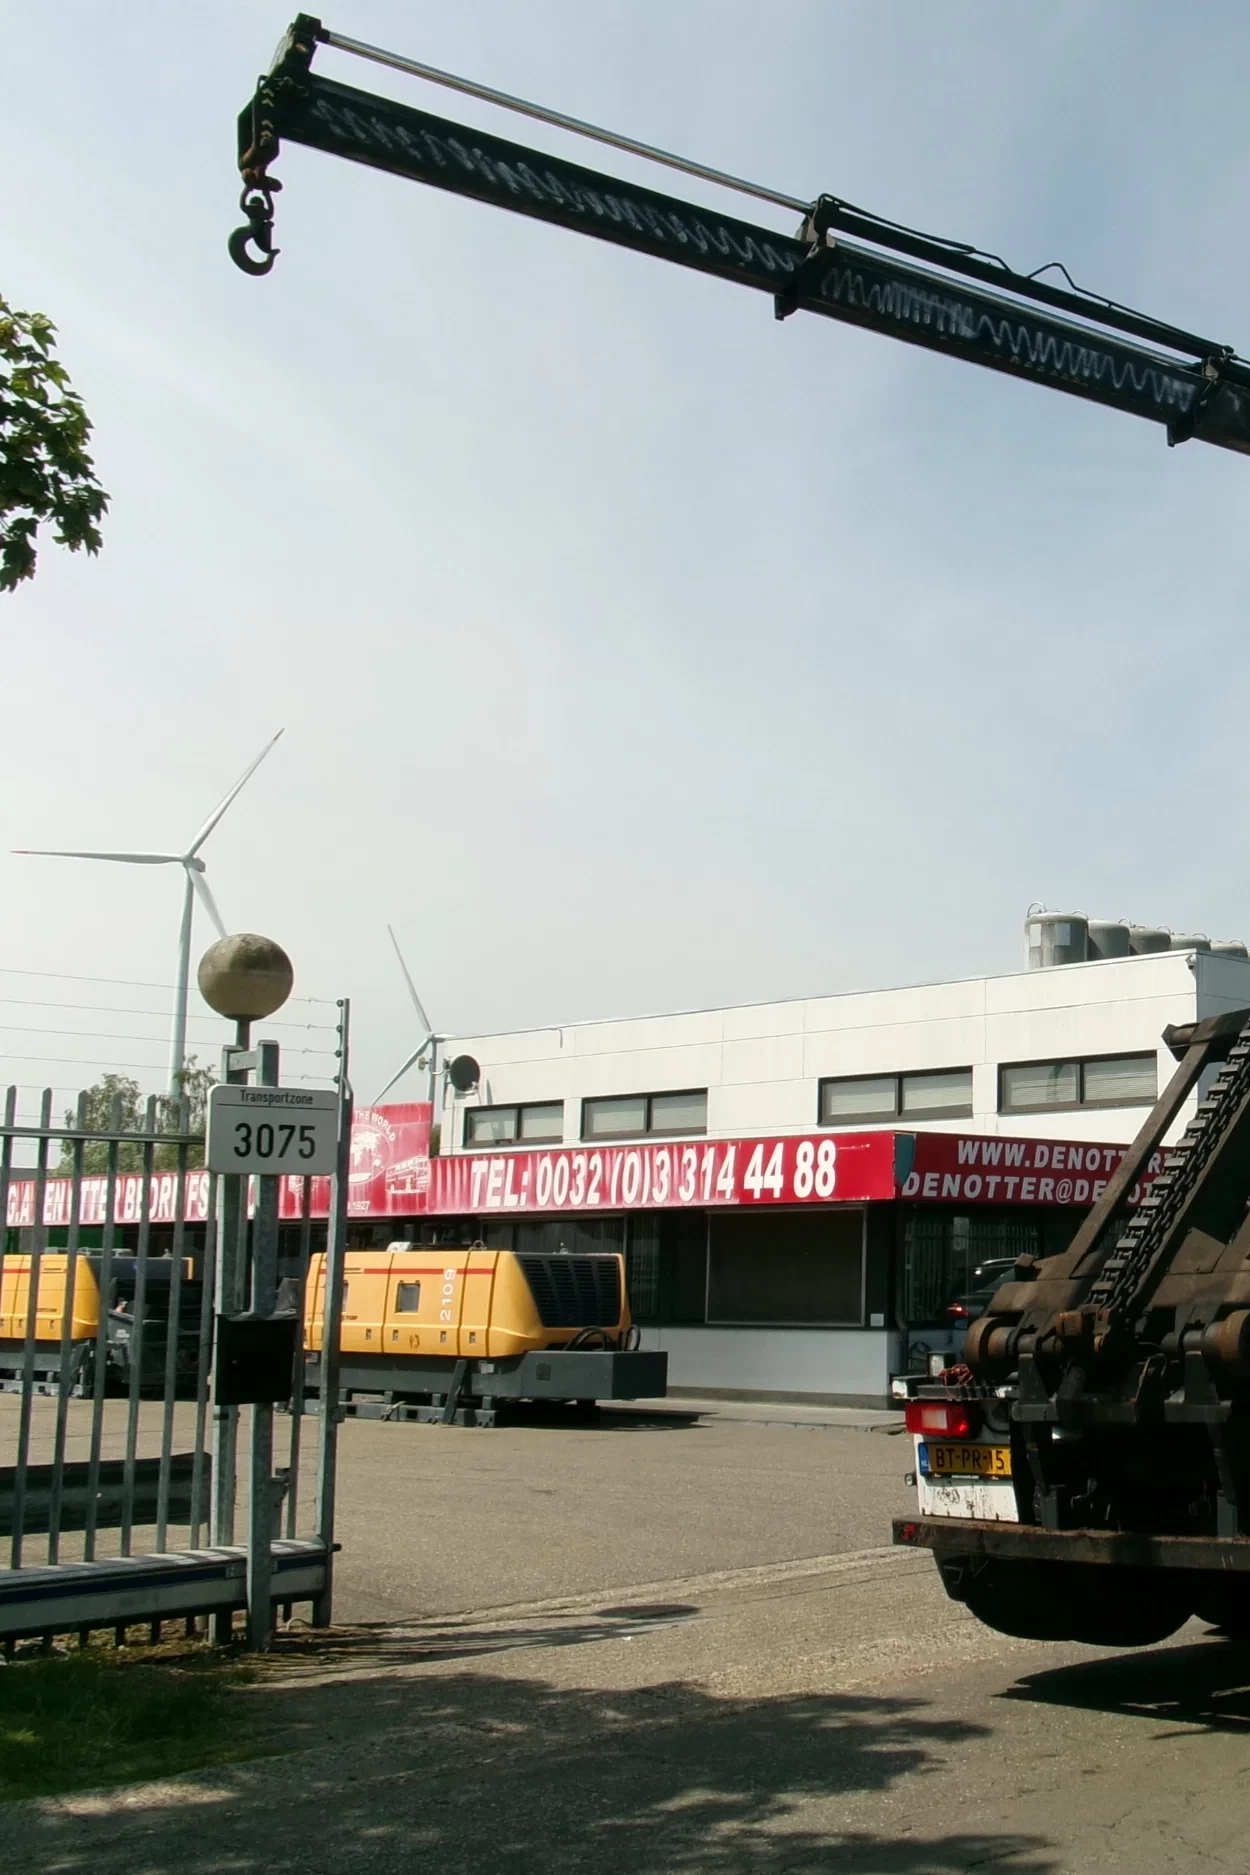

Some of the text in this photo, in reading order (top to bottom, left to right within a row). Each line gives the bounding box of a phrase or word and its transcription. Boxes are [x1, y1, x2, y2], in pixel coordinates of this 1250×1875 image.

[240, 1089, 313, 1105] Transportzone
[233, 1122, 316, 1159] 3075
[371, 1112, 396, 1142] WORLD
[471, 1158, 529, 1208] TEL:
[536, 1153, 602, 1207] 0032
[678, 1145, 736, 1202] 314
[743, 1142, 785, 1199] 44
[793, 1139, 837, 1199] 88
[41, 1180, 66, 1222] EN
[352, 1200, 370, 1211] 1927
[439, 1268, 457, 1322] 2109
[935, 1447, 1005, 1471] BT-PR-15
